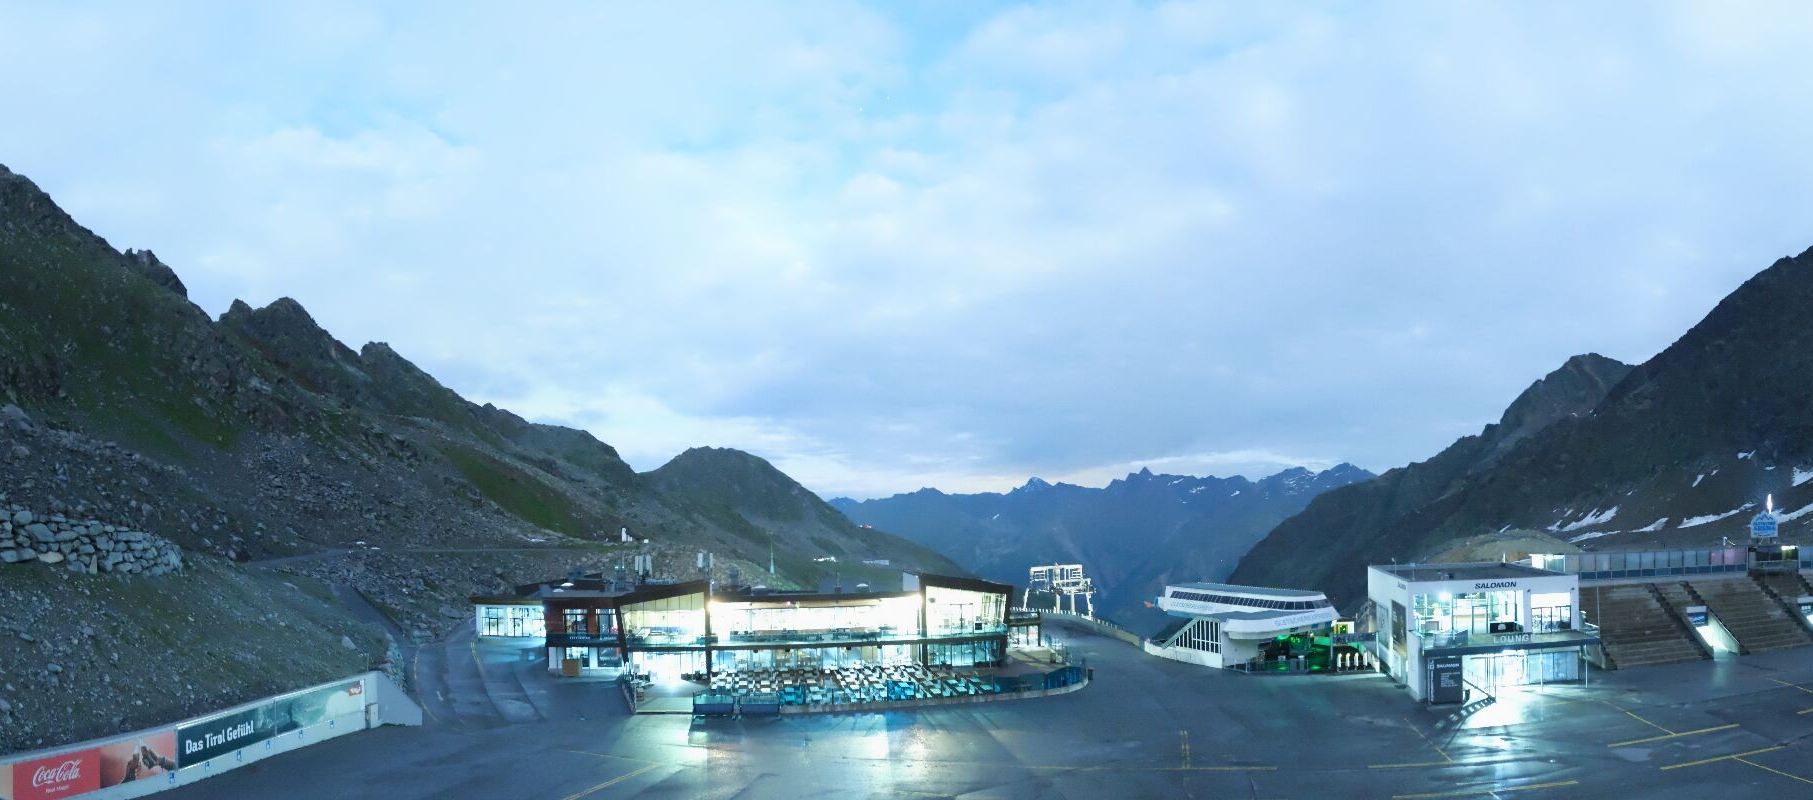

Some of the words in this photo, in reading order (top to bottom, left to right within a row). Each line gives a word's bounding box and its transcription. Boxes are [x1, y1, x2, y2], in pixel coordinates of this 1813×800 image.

[1474, 581, 1517, 590] SALOMON
[1493, 633, 1536, 644] LOUNGE
[185, 739, 204, 754] Das
[205, 729, 226, 748] Tirol
[226, 720, 254, 742] Gefühl
